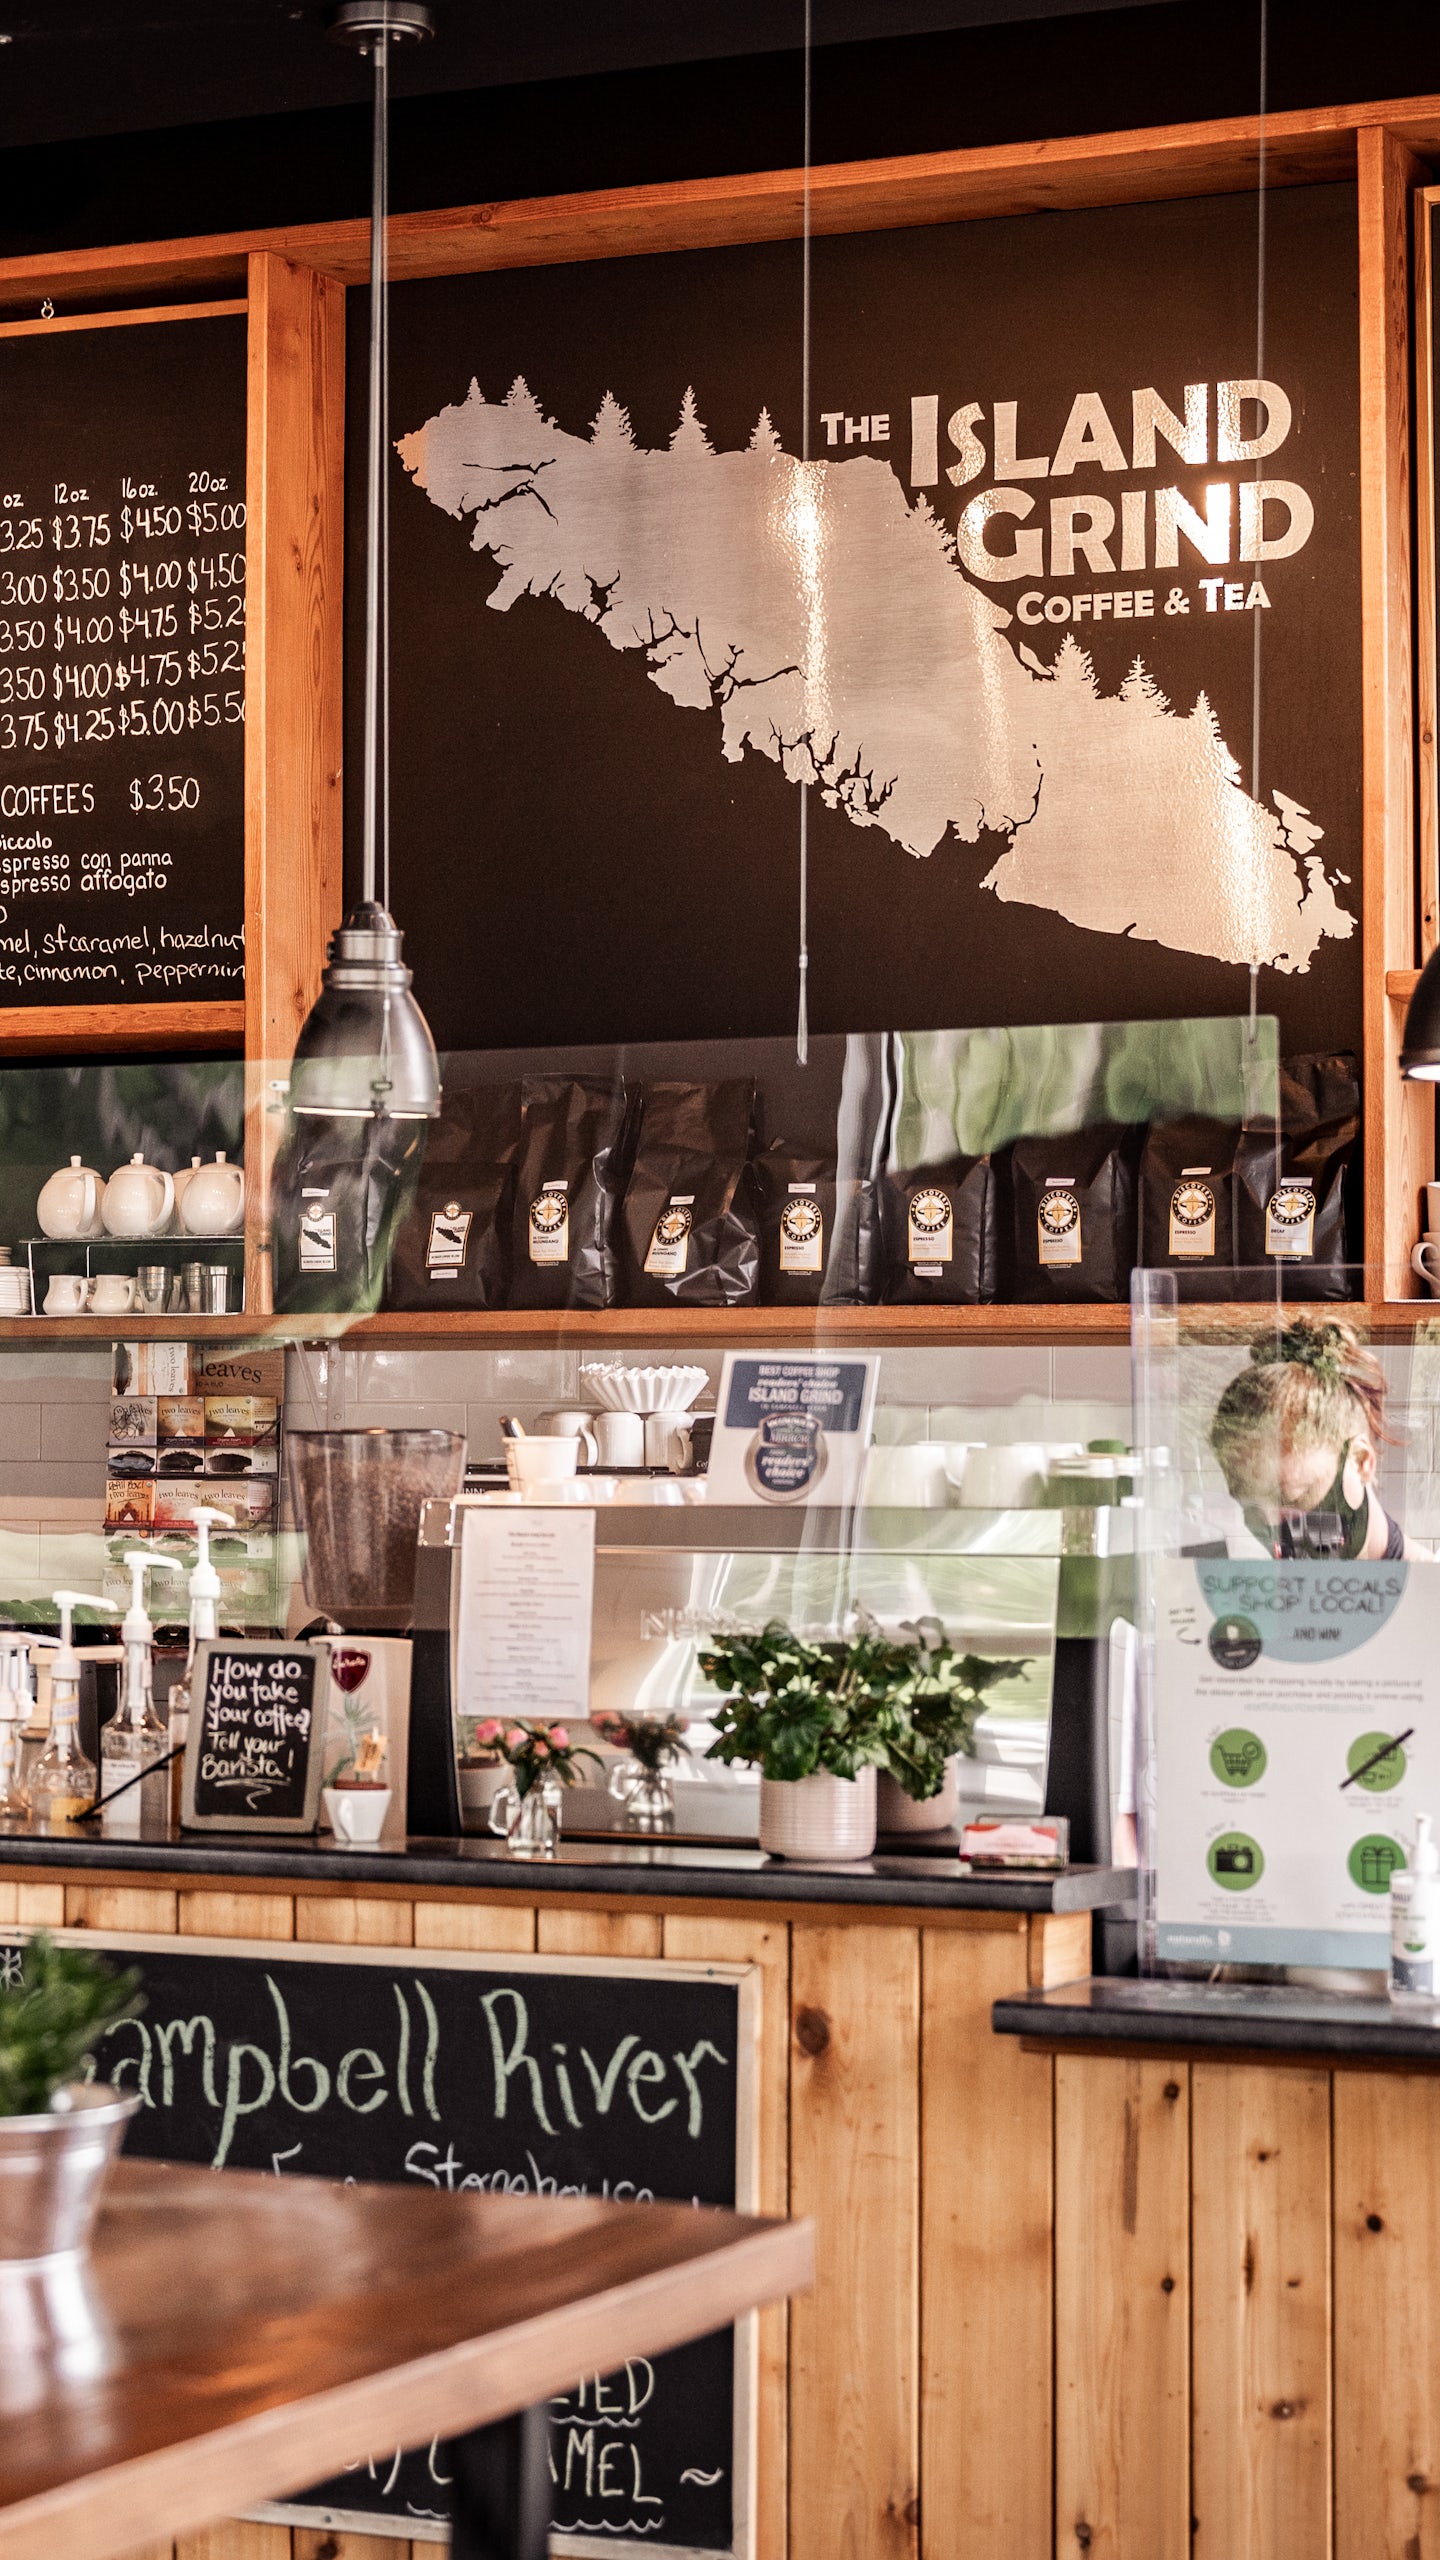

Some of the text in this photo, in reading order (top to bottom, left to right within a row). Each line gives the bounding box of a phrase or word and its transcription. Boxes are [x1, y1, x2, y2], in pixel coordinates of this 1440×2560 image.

[910, 379, 1292, 487] ISLAND
[957, 480, 1315, 582] GRIND
[52, 565, 110, 603] $3.50
[119, 560, 182, 599] $4.00
[1016, 578, 1272, 626] COFFEE & TEA
[54, 613, 114, 652] $4.00
[188, 595, 246, 634] $5.2
[187, 640, 246, 680] $5.2
[188, 691, 246, 729] $5.5
[1, 774, 200, 817] COFFEES $3.50
[81, 853, 111, 870] con
[121, 852, 173, 876] panna
[80, 868, 167, 897] affogato
[200, 1353, 262, 1383] leaves
[748, 1386, 799, 1403] ISLAND
[159, 1488, 199, 1500] two leaves
[204, 1491, 220, 1500] two
[221, 1488, 246, 1500] leaves
[1203, 1575, 1401, 1596] SUPPORT LOCALS
[1239, 1595, 1300, 1614] SHOP
[213, 1656, 302, 1685] How do
[209, 1679, 299, 1708] you take
[207, 1702, 251, 1730] your
[208, 1730, 287, 1760] Tell your
[481, 1988, 728, 2138] River
